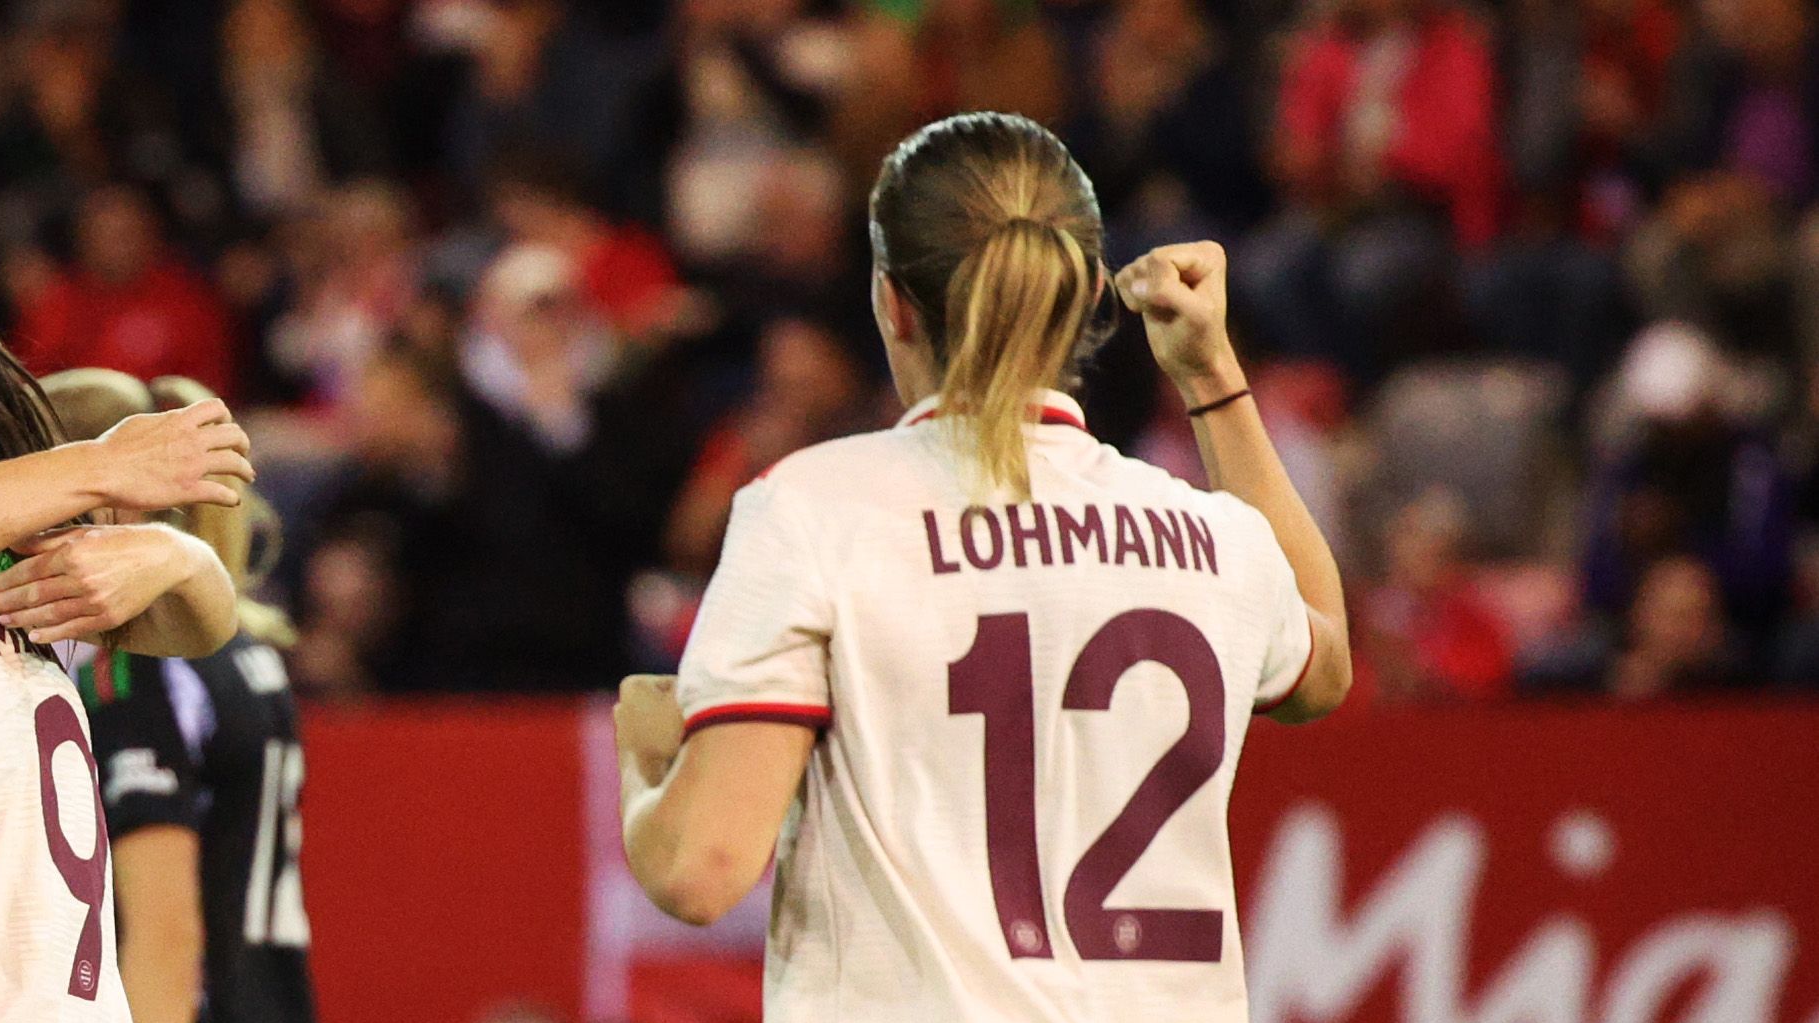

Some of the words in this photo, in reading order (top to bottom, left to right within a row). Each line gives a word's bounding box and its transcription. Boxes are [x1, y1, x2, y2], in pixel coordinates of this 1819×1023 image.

[923, 503, 1219, 575] LOHMANN
[34, 694, 108, 1002] 9
[948, 608, 1226, 962] 12
